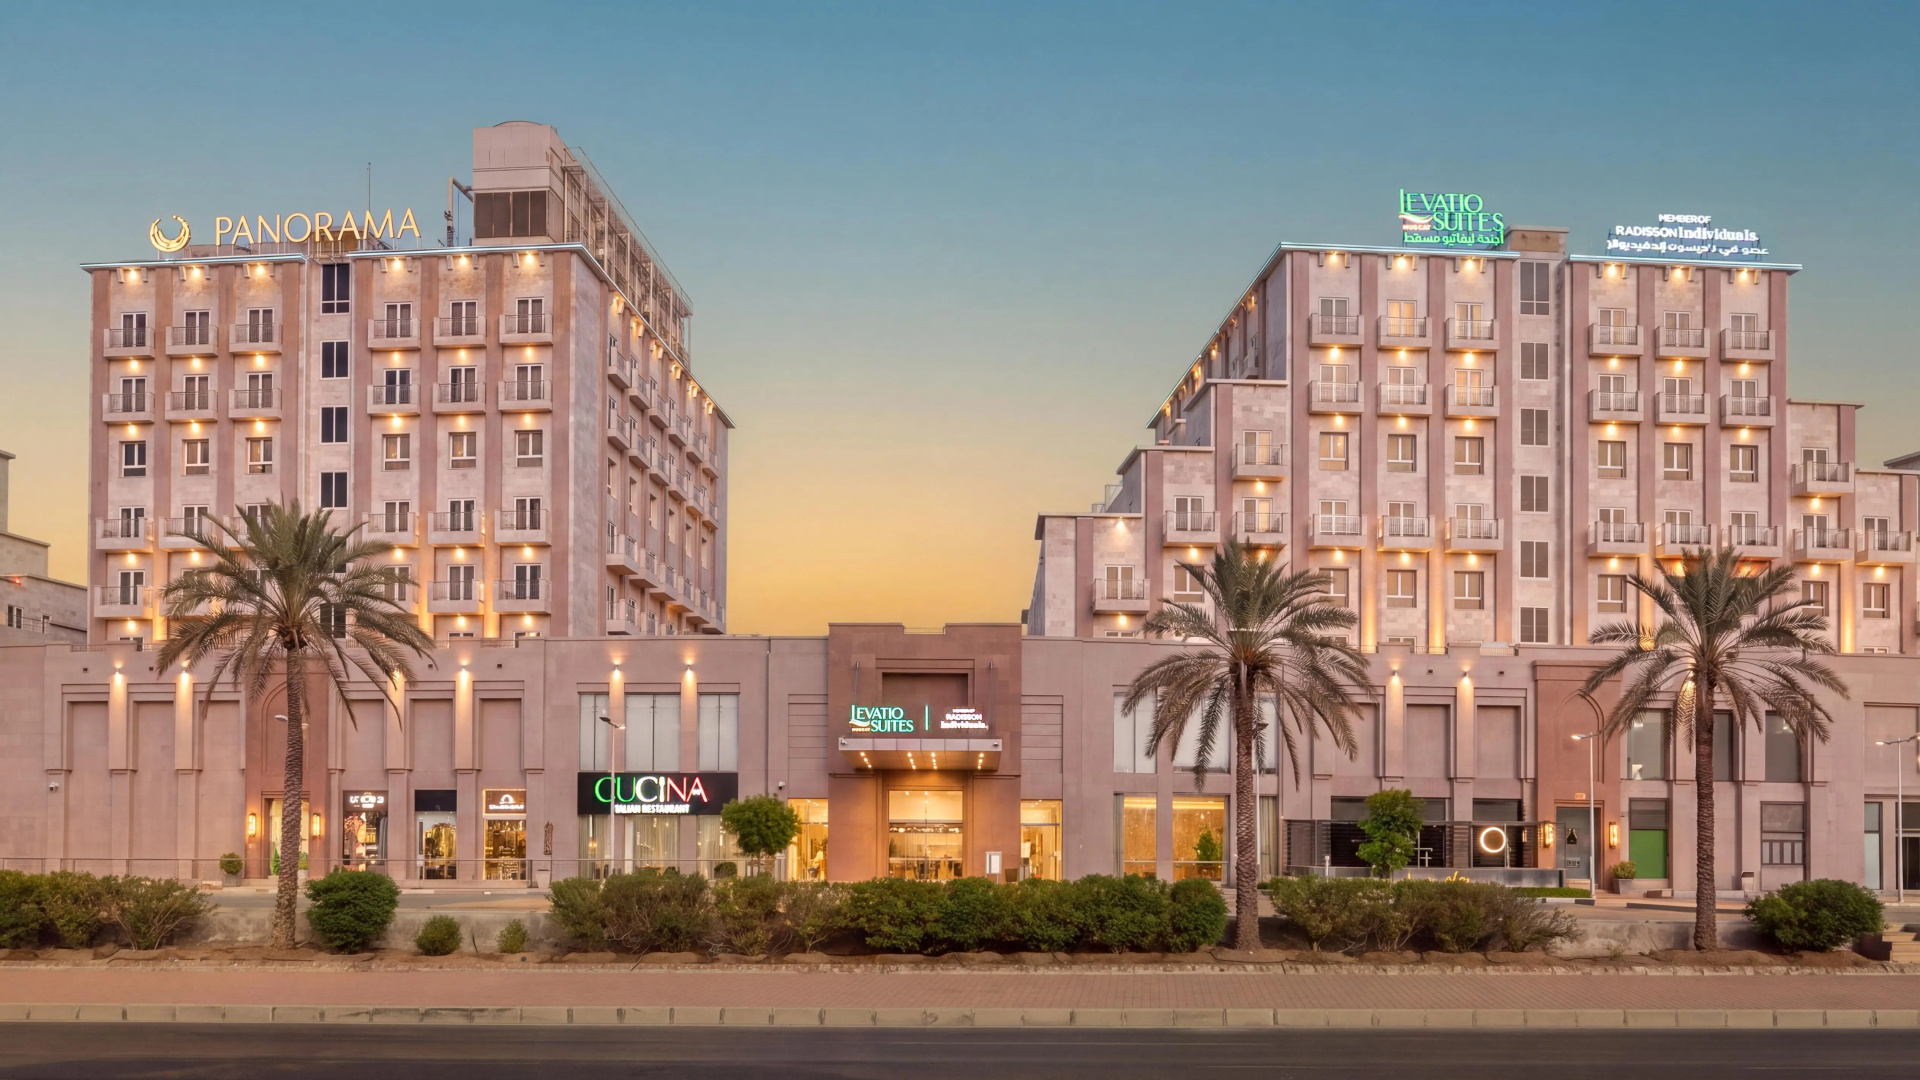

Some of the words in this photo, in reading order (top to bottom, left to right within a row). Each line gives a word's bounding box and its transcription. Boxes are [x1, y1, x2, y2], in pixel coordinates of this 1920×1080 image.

[1400, 188, 1484, 213] LEVATIO
[1432, 212, 1505, 232] SUITES
[1659, 213, 1698, 223] MEMBER
[215, 207, 421, 246] PANORAMA
[1615, 225, 1678, 238] RADISSON
[1403, 231, 1441, 243] مسقط
[851, 704, 904, 720] LEVATIO
[870, 719, 915, 733] SUITES
[594, 776, 708, 803] CUCINA
[612, 803, 641, 814] TALIAN
